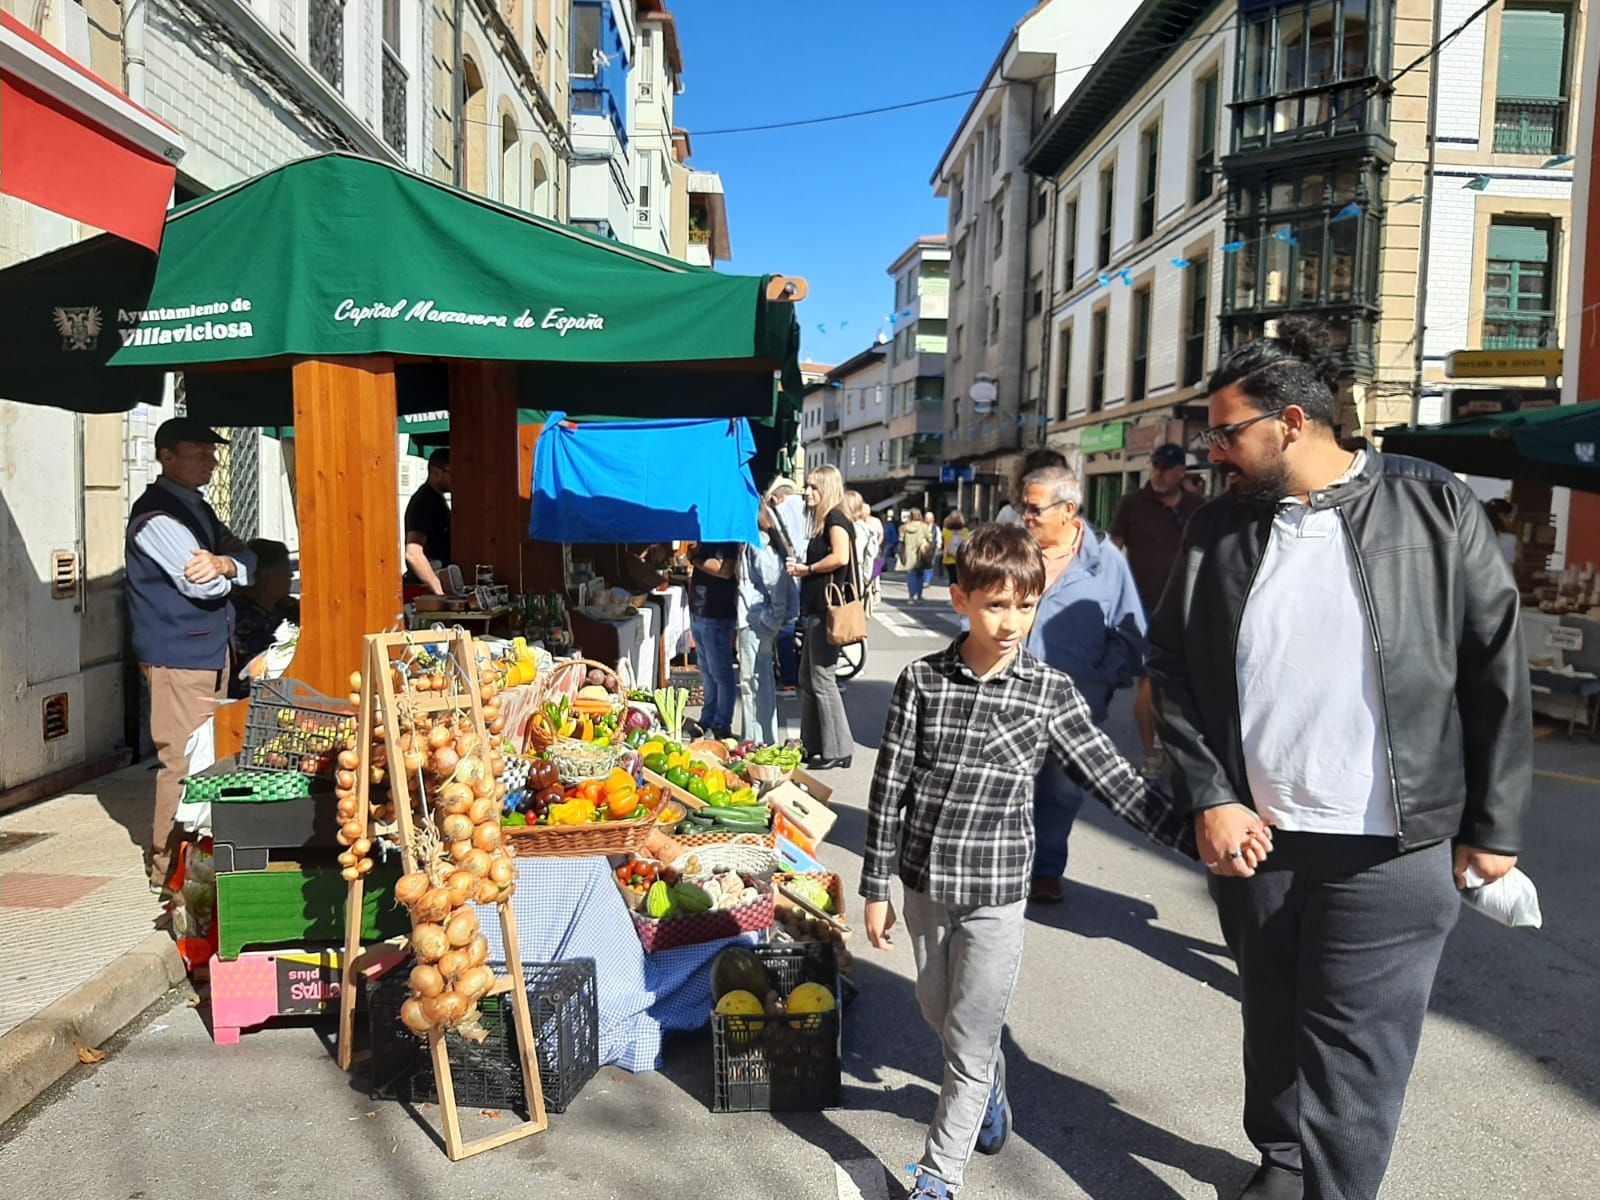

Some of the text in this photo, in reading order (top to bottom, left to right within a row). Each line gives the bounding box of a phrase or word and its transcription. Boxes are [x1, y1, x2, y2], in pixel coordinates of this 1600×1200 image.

[117, 297, 252, 324] Ayuntamiento de
[334, 299, 604, 337] Capital Manzanera de España
[118, 321, 253, 347] Villaviciosa
[288, 967, 320, 981] plus
